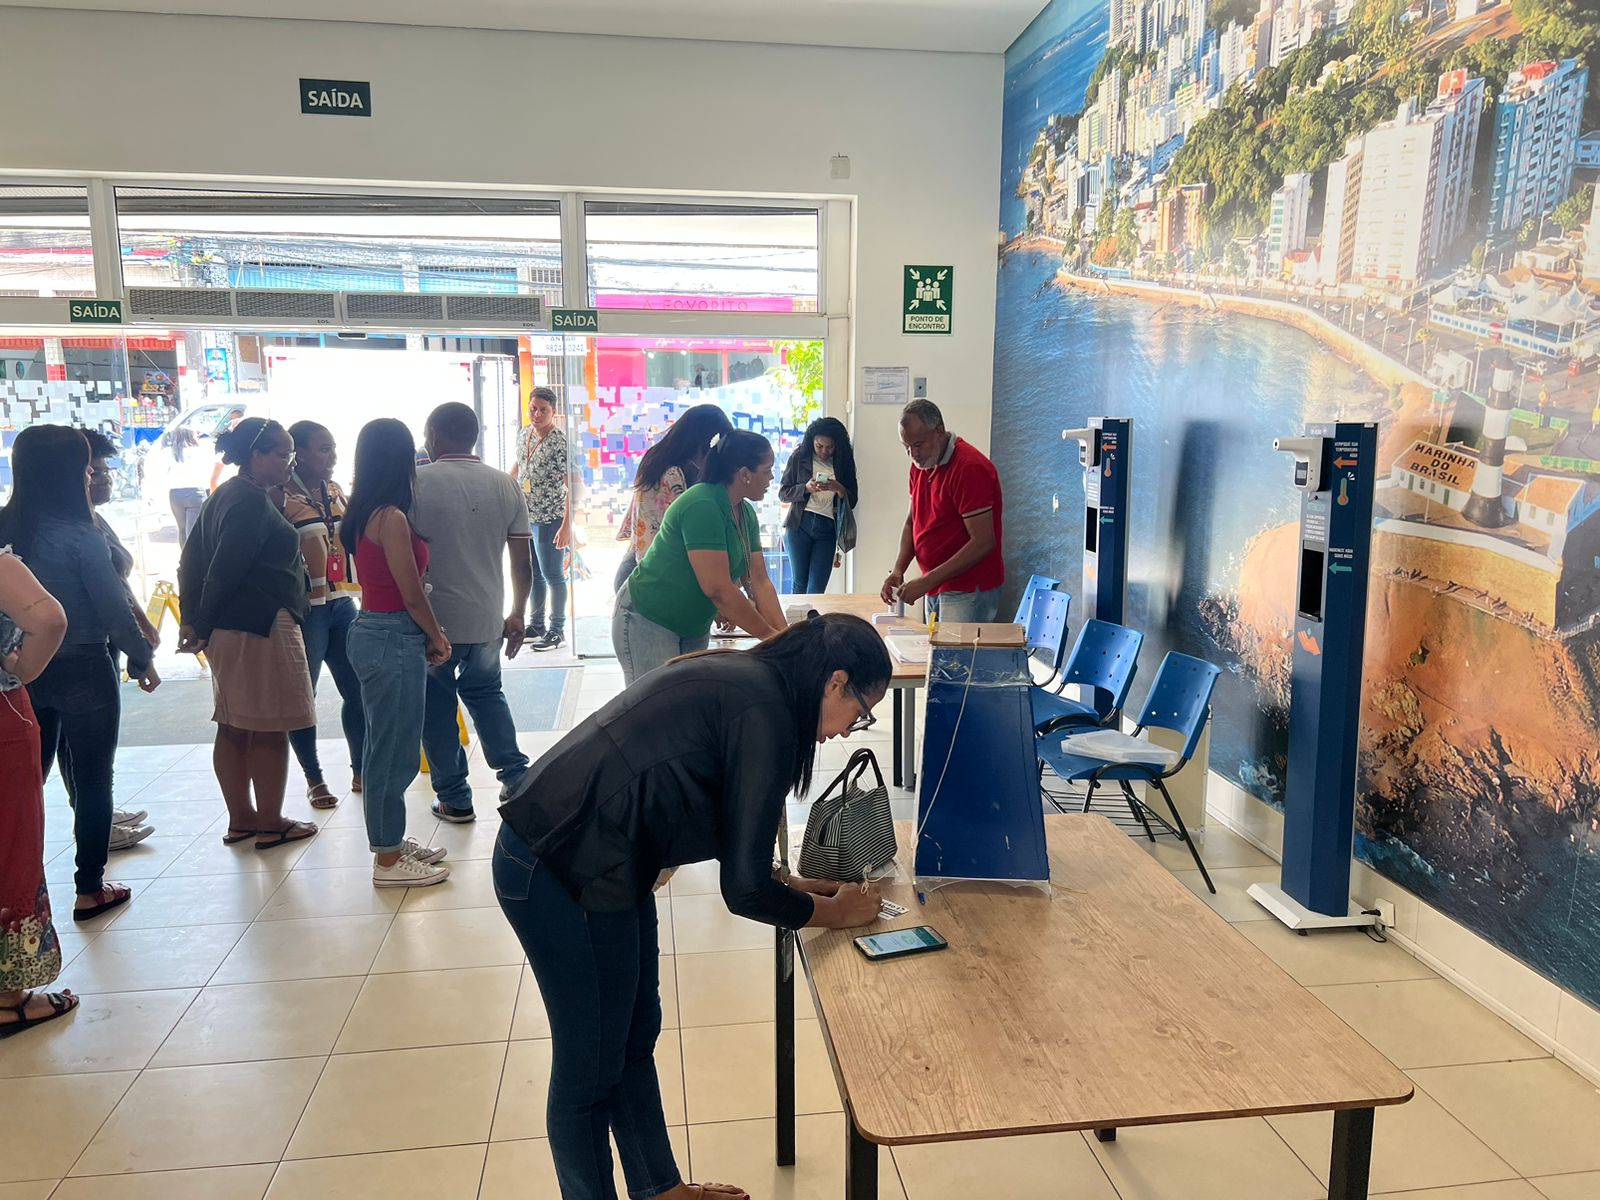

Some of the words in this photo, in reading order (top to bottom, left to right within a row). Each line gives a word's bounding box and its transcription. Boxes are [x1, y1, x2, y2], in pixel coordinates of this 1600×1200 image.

[308, 88, 364, 108] SAÍDA
[72, 303, 120, 318] SAÍDA
[554, 312, 597, 326] SAÍDA
[1415, 444, 1476, 469] MARINHA
[1431, 459, 1450, 471] DO
[1410, 462, 1460, 486] BRASIL
